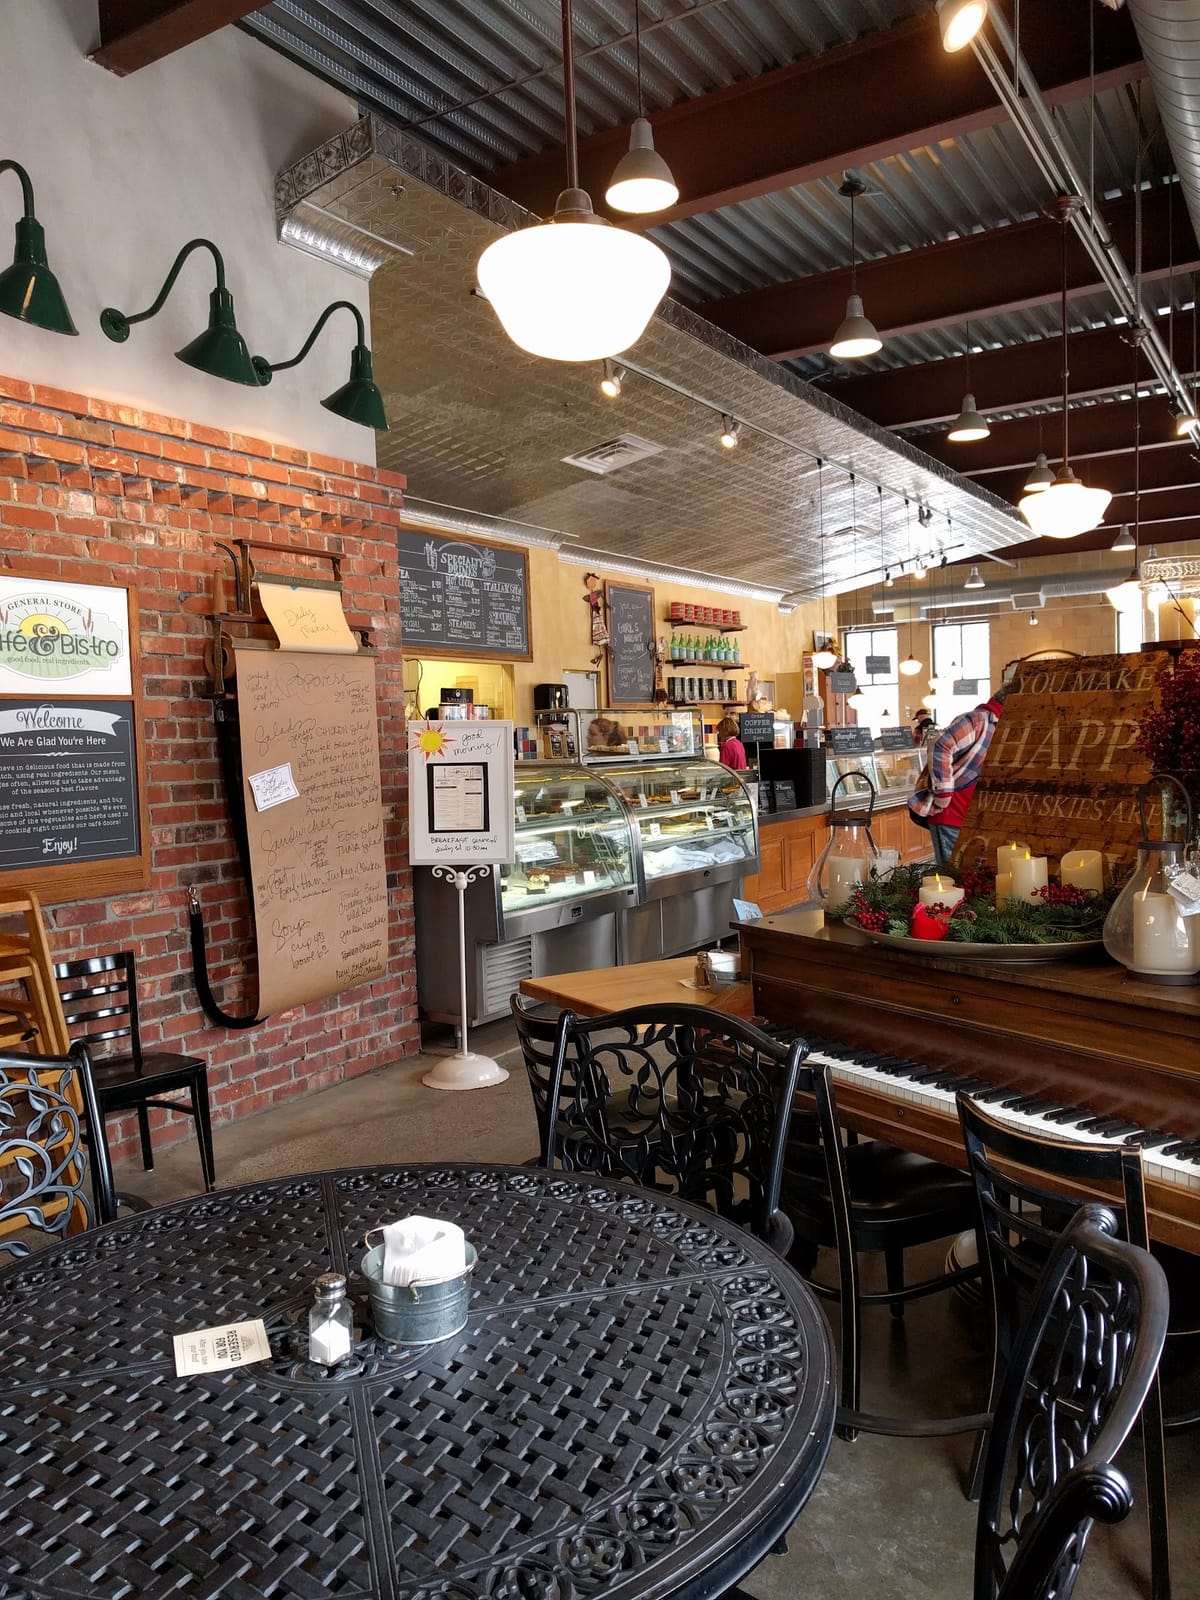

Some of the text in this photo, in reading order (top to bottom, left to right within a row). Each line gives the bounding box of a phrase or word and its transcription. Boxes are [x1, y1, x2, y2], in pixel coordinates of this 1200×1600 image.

[441, 553, 483, 568] SPECIALTY
[448, 563, 478, 577] DRINKS
[483, 582, 510, 594] ITALIAN
[7, 598, 82, 616] GENERAL STORE
[283, 605, 316, 627] Daily
[448, 619, 477, 630] STEAMERS
[0, 629, 27, 652] fé
[60, 633, 119, 657] Bistro
[1017, 666, 1155, 696] YOU MAKE
[16, 704, 84, 729] Welcome
[744, 719, 771, 727] COFFEE
[744, 727, 772, 735] DRINKS
[0, 735, 107, 747] We Are Glad You're Here
[462, 729, 484, 748] good
[989, 718, 1142, 772] HAPP
[25, 763, 54, 771] delicious
[111, 760, 127, 768] from
[16, 772, 35, 780] using
[36, 771, 50, 779] real
[32, 778, 60, 786] allowing
[94, 776, 126, 784] advantage
[11, 788, 20, 796] of
[33, 786, 60, 794] season's
[11, 802, 33, 810] fresh,
[33, 800, 59, 808] natural
[59, 798, 99, 807] ingredients,
[111, 796, 124, 804] buy
[977, 790, 1038, 817] WHEN
[1038, 794, 1106, 821] SKIES
[10, 810, 24, 818] and
[24, 809, 41, 817] local
[41, 807, 74, 816] whenever
[112, 803, 128, 811] even
[18, 818, 27, 826] of
[27, 817, 39, 825] the
[39, 815, 75, 824] vegetables
[88, 812, 107, 820] herbs
[5, 826, 32, 835] cooking
[32, 825, 50, 833] right
[51, 822, 75, 831] outside
[42, 836, 78, 855] Enjoy!
[216, 1337, 228, 1359] FOR YOU
[227, 1330, 241, 1361] RESERVED
